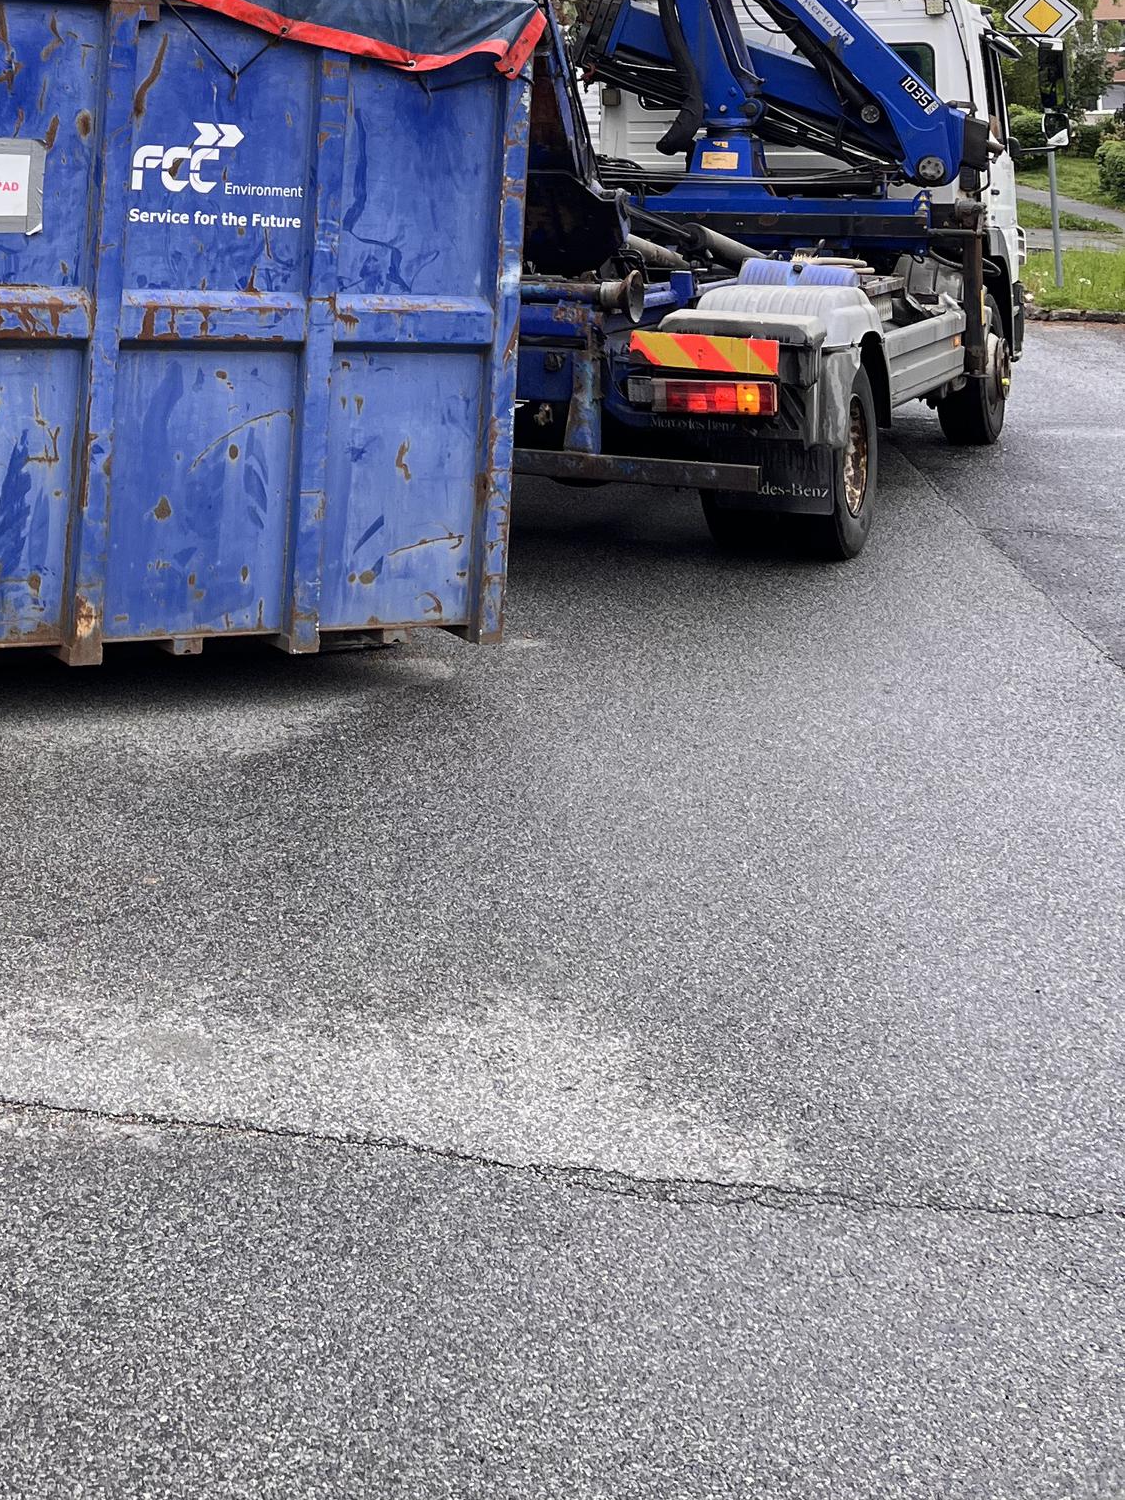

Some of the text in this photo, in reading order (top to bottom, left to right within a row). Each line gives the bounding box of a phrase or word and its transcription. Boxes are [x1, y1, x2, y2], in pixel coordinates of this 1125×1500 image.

[822, 15, 834, 28] to
[901, 76, 932, 107] 1035
[131, 145, 303, 198] FCC Environment
[129, 208, 302, 228] Service for the Future
[758, 482, 829, 498] des-Benz
